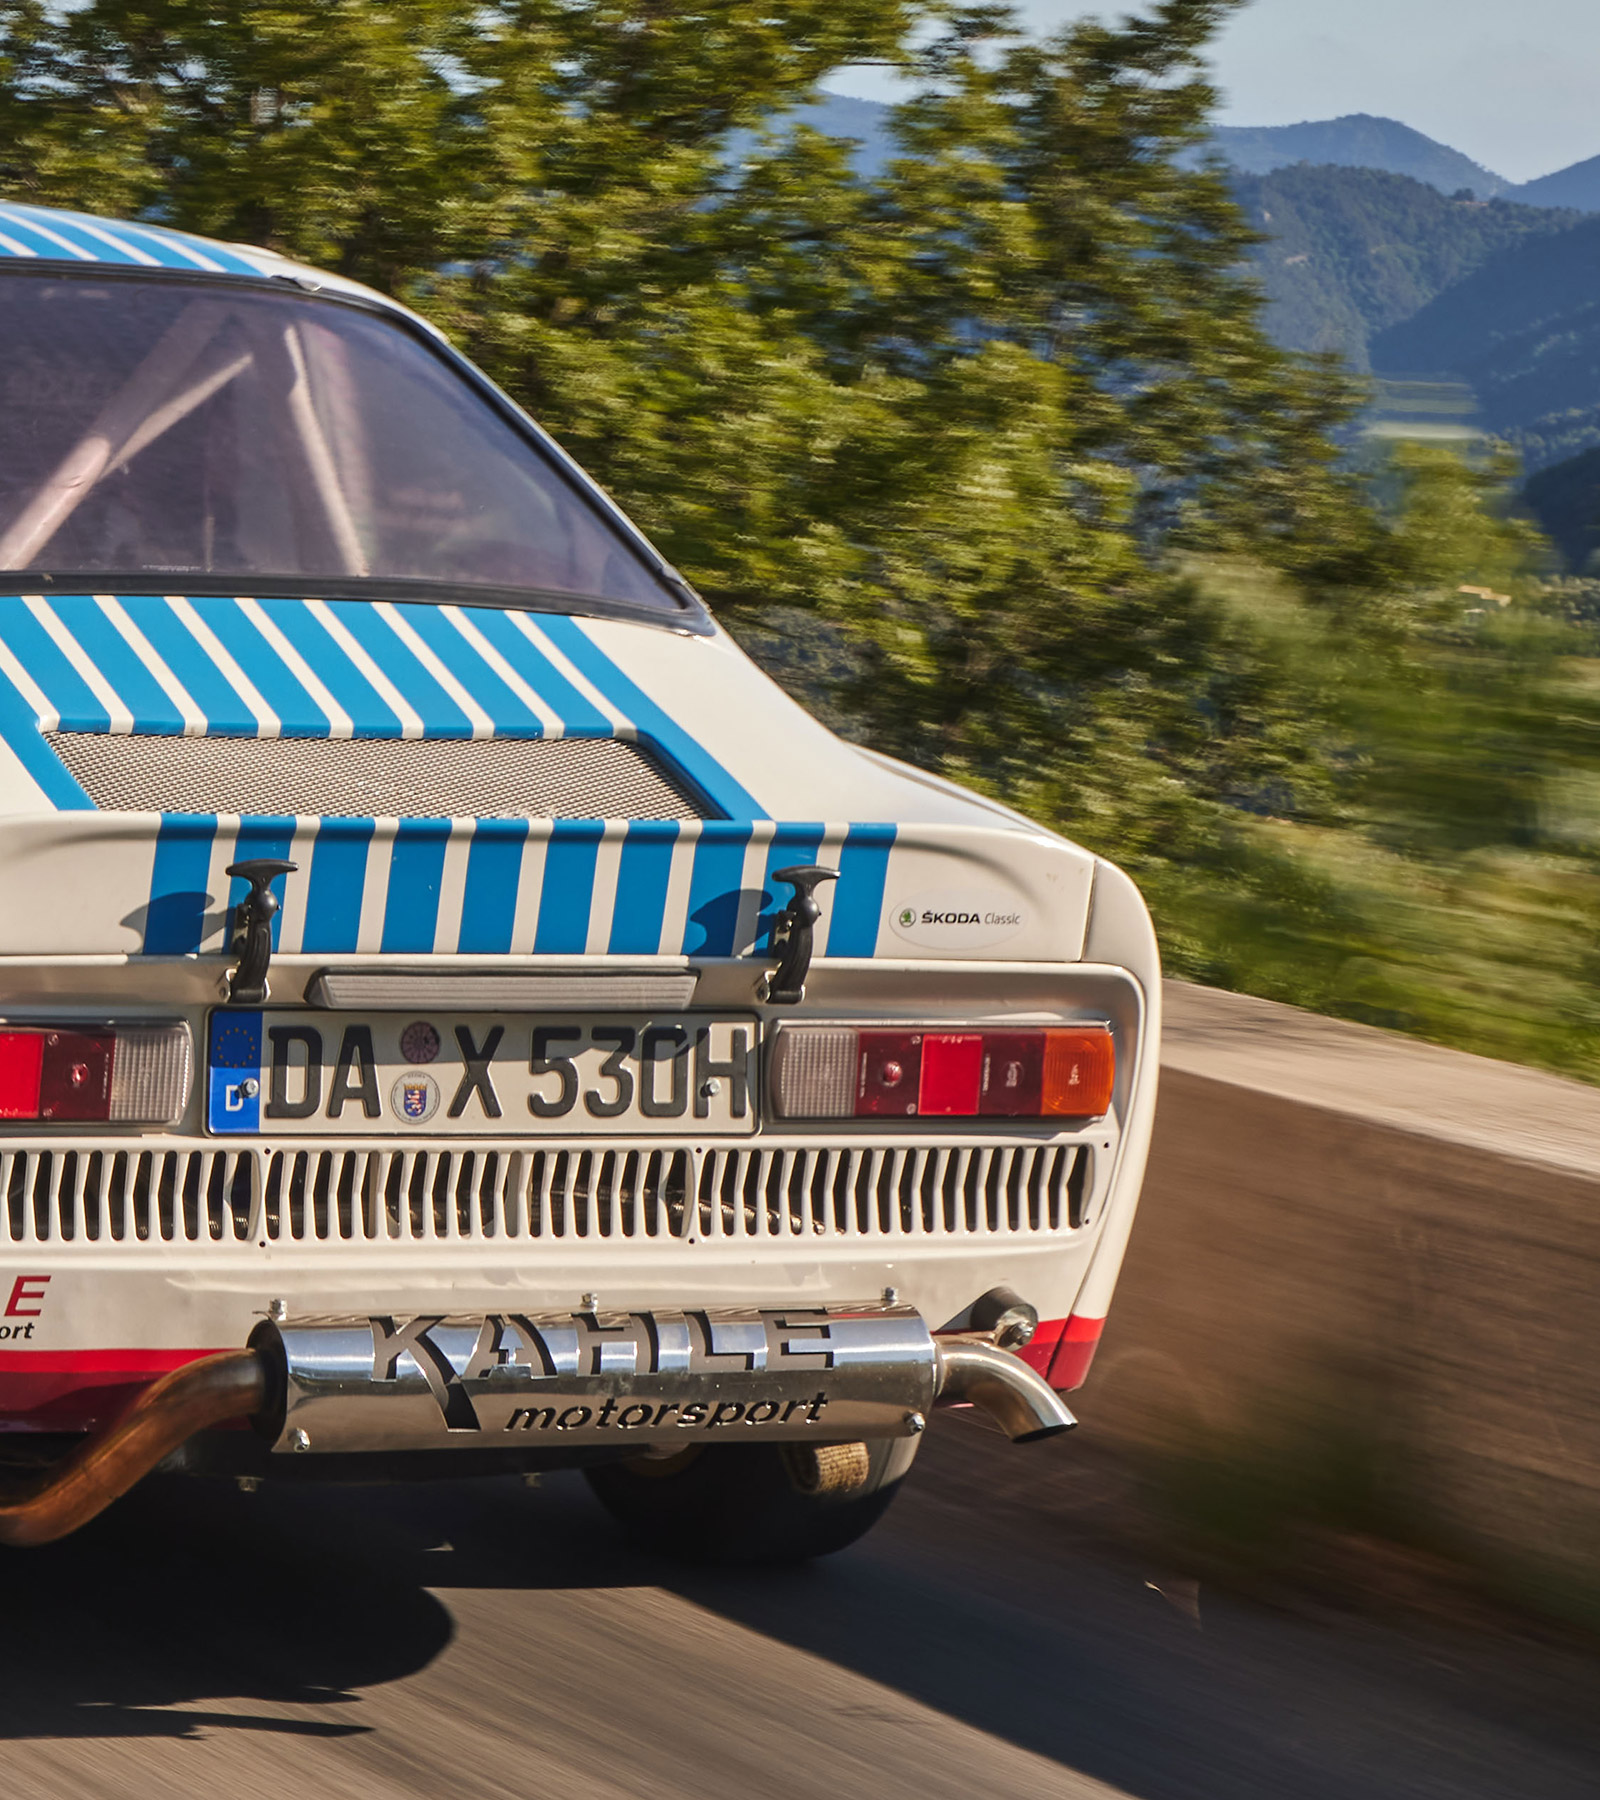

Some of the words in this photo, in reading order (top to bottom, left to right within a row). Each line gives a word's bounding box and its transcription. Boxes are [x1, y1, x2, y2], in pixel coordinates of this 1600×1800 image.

[922, 910, 981, 924] ŠKODA
[984, 912, 1021, 925] Classic
[267, 1024, 382, 1119] DA
[447, 1025, 505, 1118] X
[528, 1025, 750, 1118] 530H
[225, 1086, 241, 1113] D
[369, 1308, 835, 1432] KAHLE
[504, 1391, 830, 1431] motorsport
